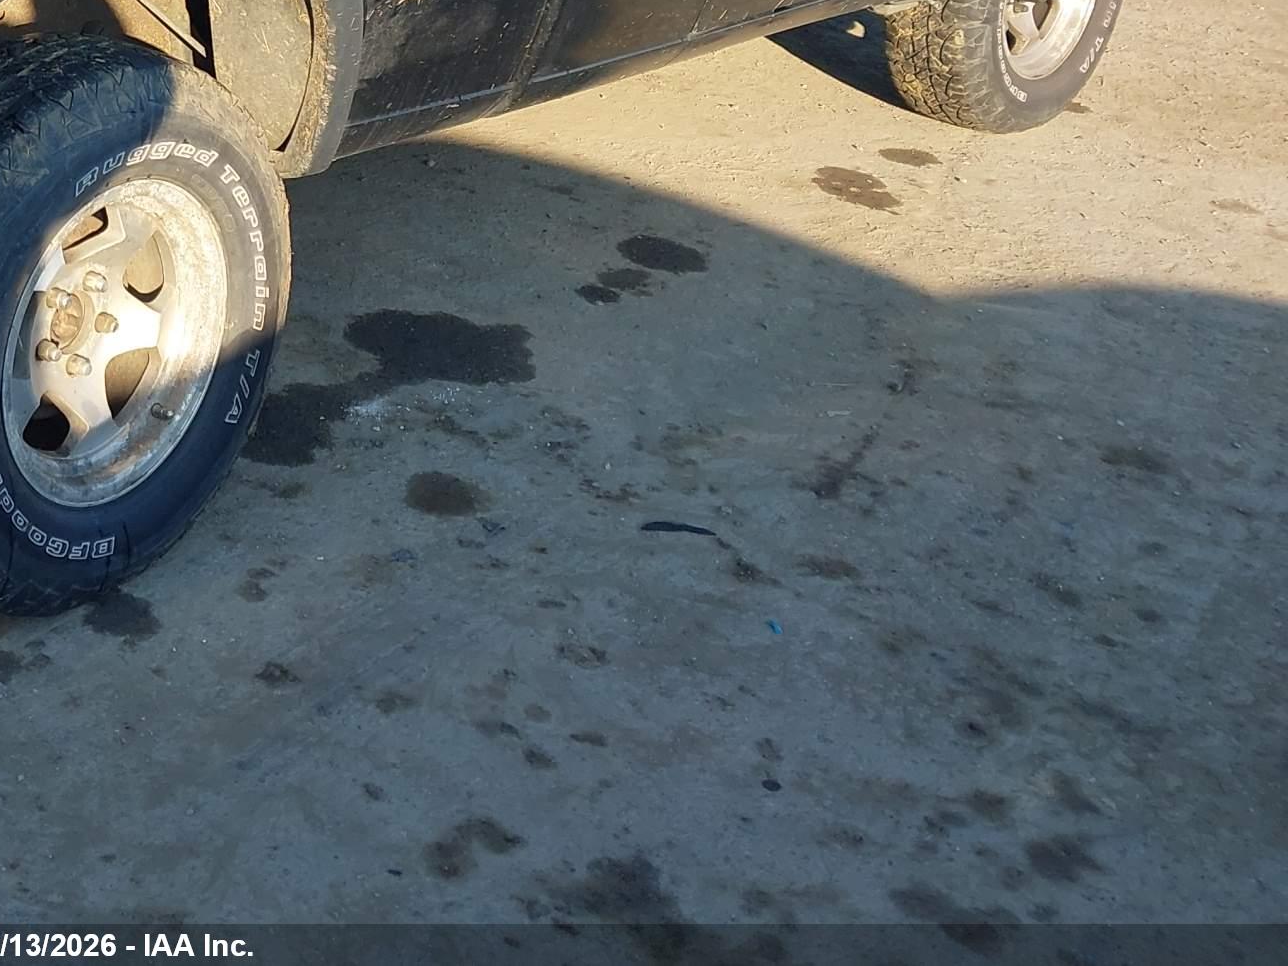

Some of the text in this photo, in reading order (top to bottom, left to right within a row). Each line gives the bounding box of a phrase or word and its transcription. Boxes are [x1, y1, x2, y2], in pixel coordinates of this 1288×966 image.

[75, 141, 219, 197] Rugged
[218, 164, 269, 331] Terrain
[224, 349, 261, 424] T/A
